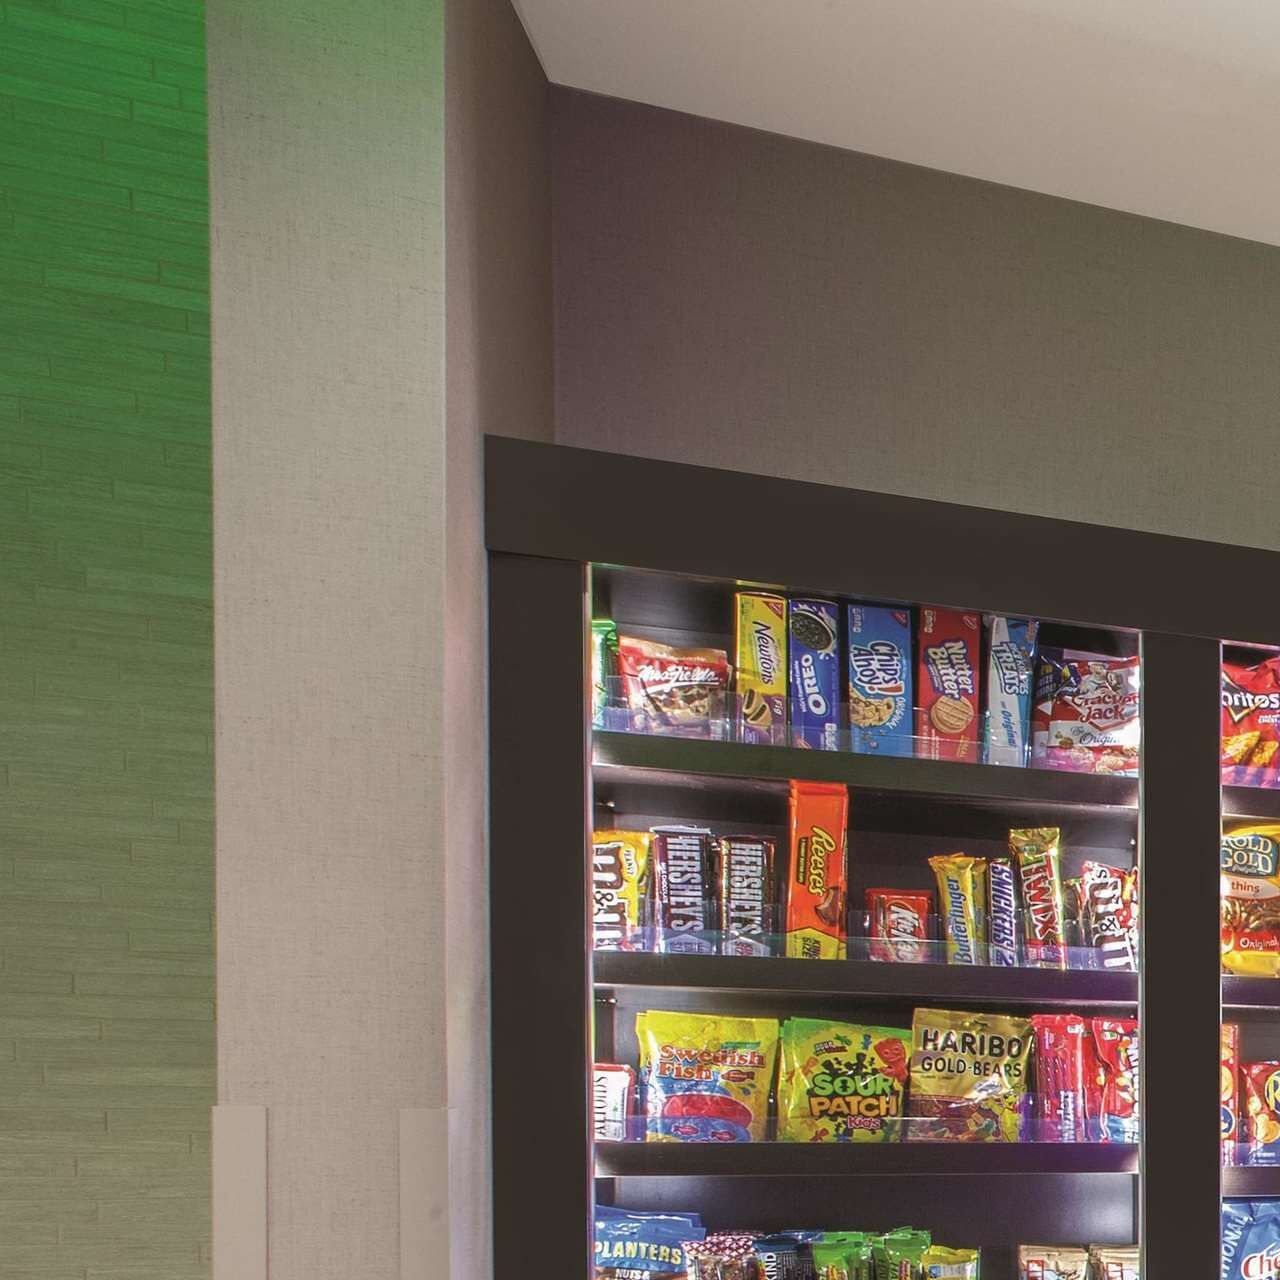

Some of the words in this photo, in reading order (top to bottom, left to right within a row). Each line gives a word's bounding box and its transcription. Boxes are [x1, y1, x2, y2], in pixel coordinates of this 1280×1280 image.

[753, 620, 775, 686] Newtons
[868, 642, 898, 687] Chips
[946, 640, 974, 694] Nutter
[929, 647, 960, 700] Butter
[993, 642, 1019, 695] TREATS
[801, 654, 828, 716] OREO
[1222, 691, 1280, 709] oritos
[774, 698, 783, 716] Fig
[1080, 704, 1127, 723] Jack
[1000, 708, 1018, 749] Original
[806, 825, 836, 897] Reese's
[1221, 849, 1273, 874] GOLD
[667, 836, 704, 933] HERSHEY'S
[729, 842, 764, 937] HERSHEY'S
[1020, 852, 1061, 940] TWIX
[1231, 880, 1261, 893] thins
[948, 876, 973, 964] Butterfinger
[991, 862, 1015, 949] SNICKERS
[1239, 937, 1279, 950] Original
[660, 1044, 766, 1068] Swedish
[923, 1029, 1023, 1059] HARIBO
[657, 1061, 714, 1082] Fish
[921, 1056, 1023, 1078] GOLD-BEARS
[813, 1073, 894, 1097] SOUR
[809, 1095, 899, 1118] PATCH
[847, 1114, 881, 1131] Kids
[594, 1241, 682, 1265] PLANTERS
